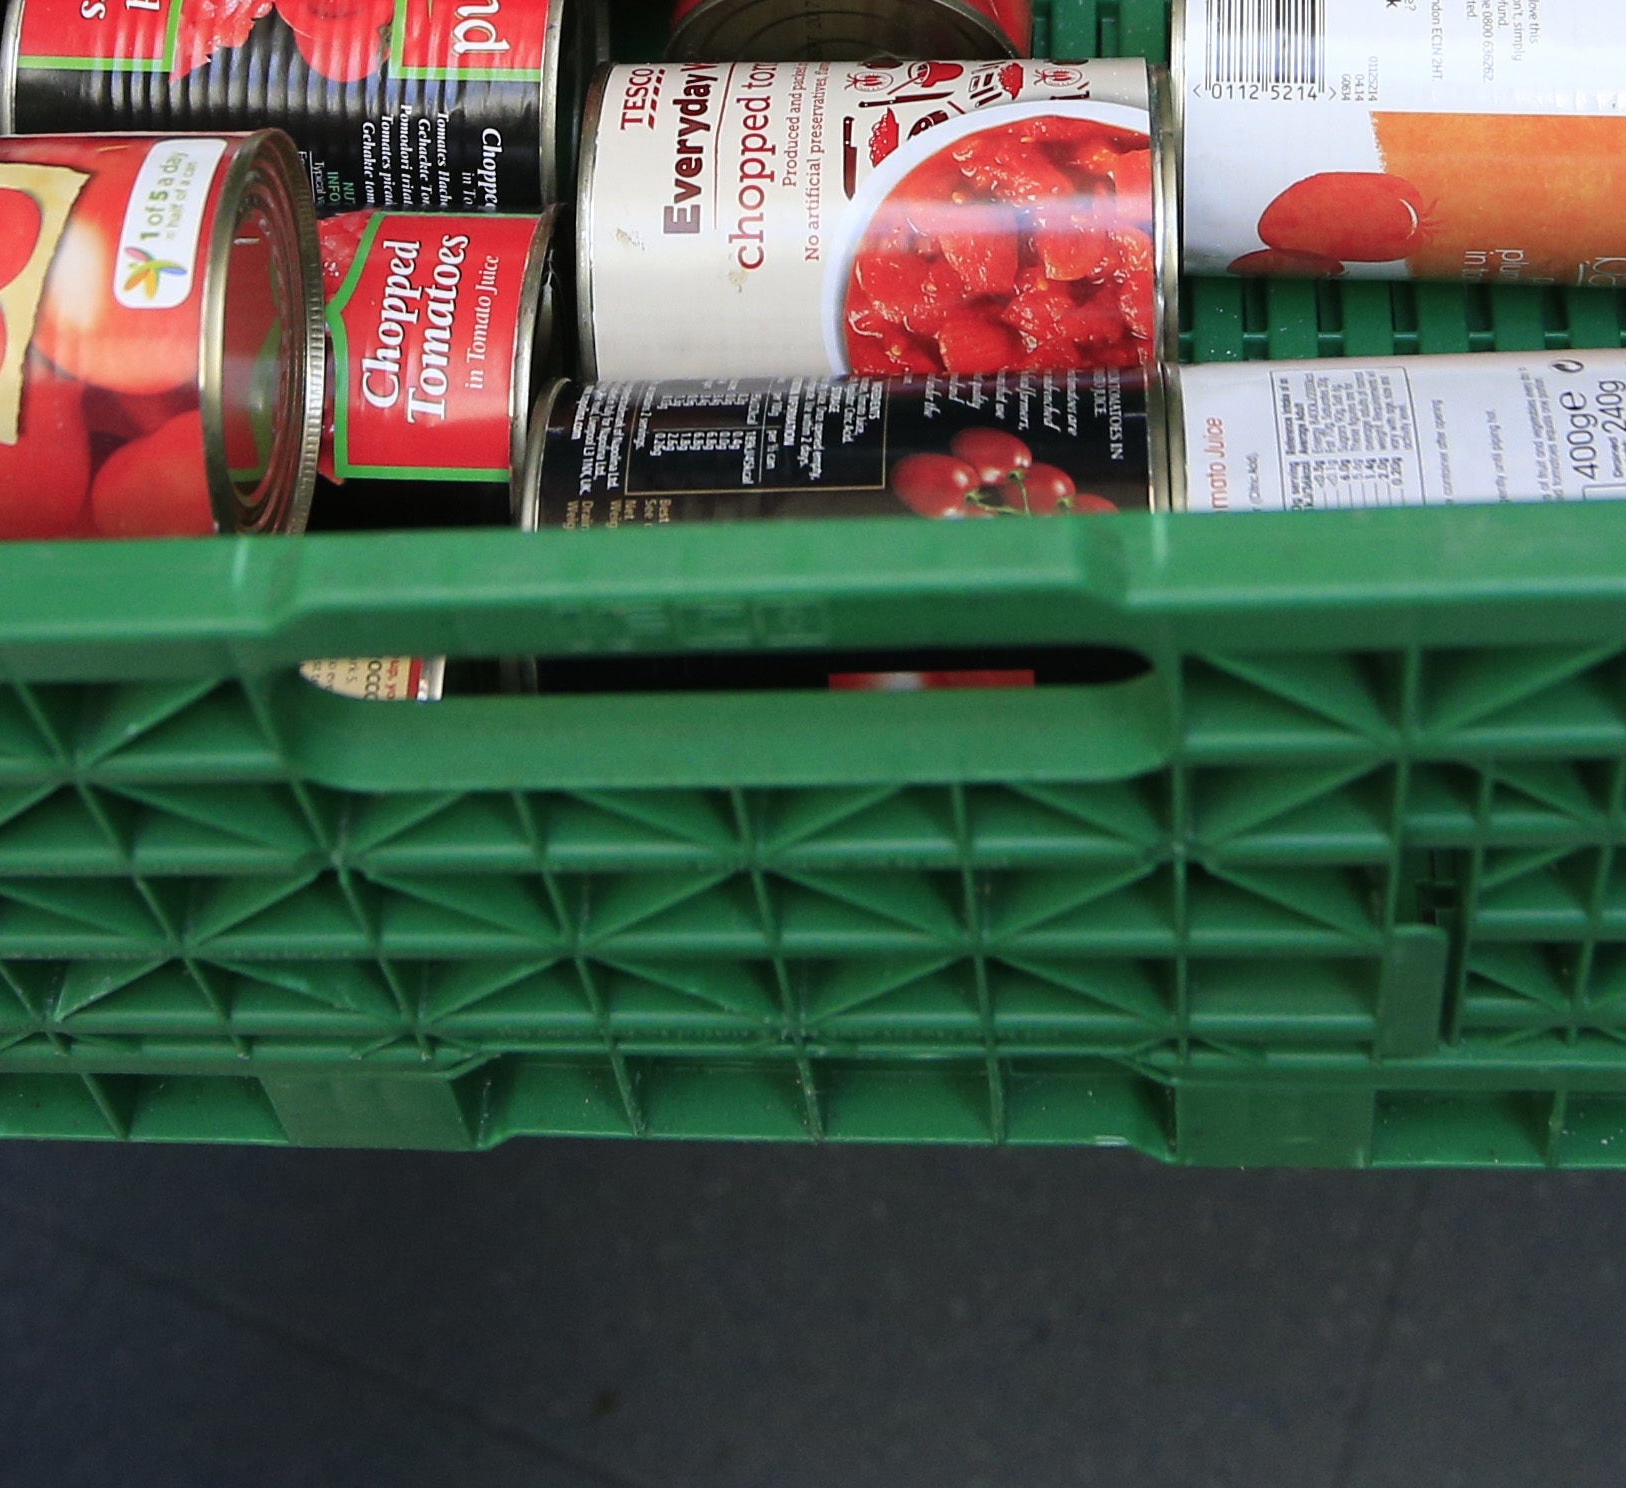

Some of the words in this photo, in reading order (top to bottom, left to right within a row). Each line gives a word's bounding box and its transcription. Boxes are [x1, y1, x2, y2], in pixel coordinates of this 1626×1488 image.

[1482, 11, 1493, 37] 0800
[620, 69, 654, 130] TESCO
[1211, 84, 1258, 100] 0112
[1271, 85, 1317, 101] 5214
[1368, 55, 1378, 101] 01125214
[787, 93, 803, 114] and
[807, 76, 828, 154] preservatives,
[362, 122, 375, 178] Gehakte
[380, 114, 394, 169] Tomates
[399, 104, 413, 169] Pomodori
[417, 118, 432, 181] Gehackte
[436, 112, 451, 167] Tomates
[663, 74, 718, 235] Everyday
[782, 117, 800, 187] Produced
[157, 177, 174, 186] a
[159, 152, 189, 173] day
[728, 96, 776, 270] chopped
[148, 191, 168, 201] 5
[805, 158, 821, 229] artificial
[140, 232, 160, 240] 1
[145, 207, 165, 226] of
[805, 234, 820, 261] No
[475, 256, 500, 295] Juice
[361, 241, 422, 409] Chopped
[406, 235, 469, 424] Tomatoes
[466, 297, 492, 364] Tomato
[465, 370, 484, 389] in
[1204, 418, 1225, 458] Juice
[1606, 437, 1624, 478] Drained
[624, 500, 636, 519] Net
[659, 499, 671, 523] Best
